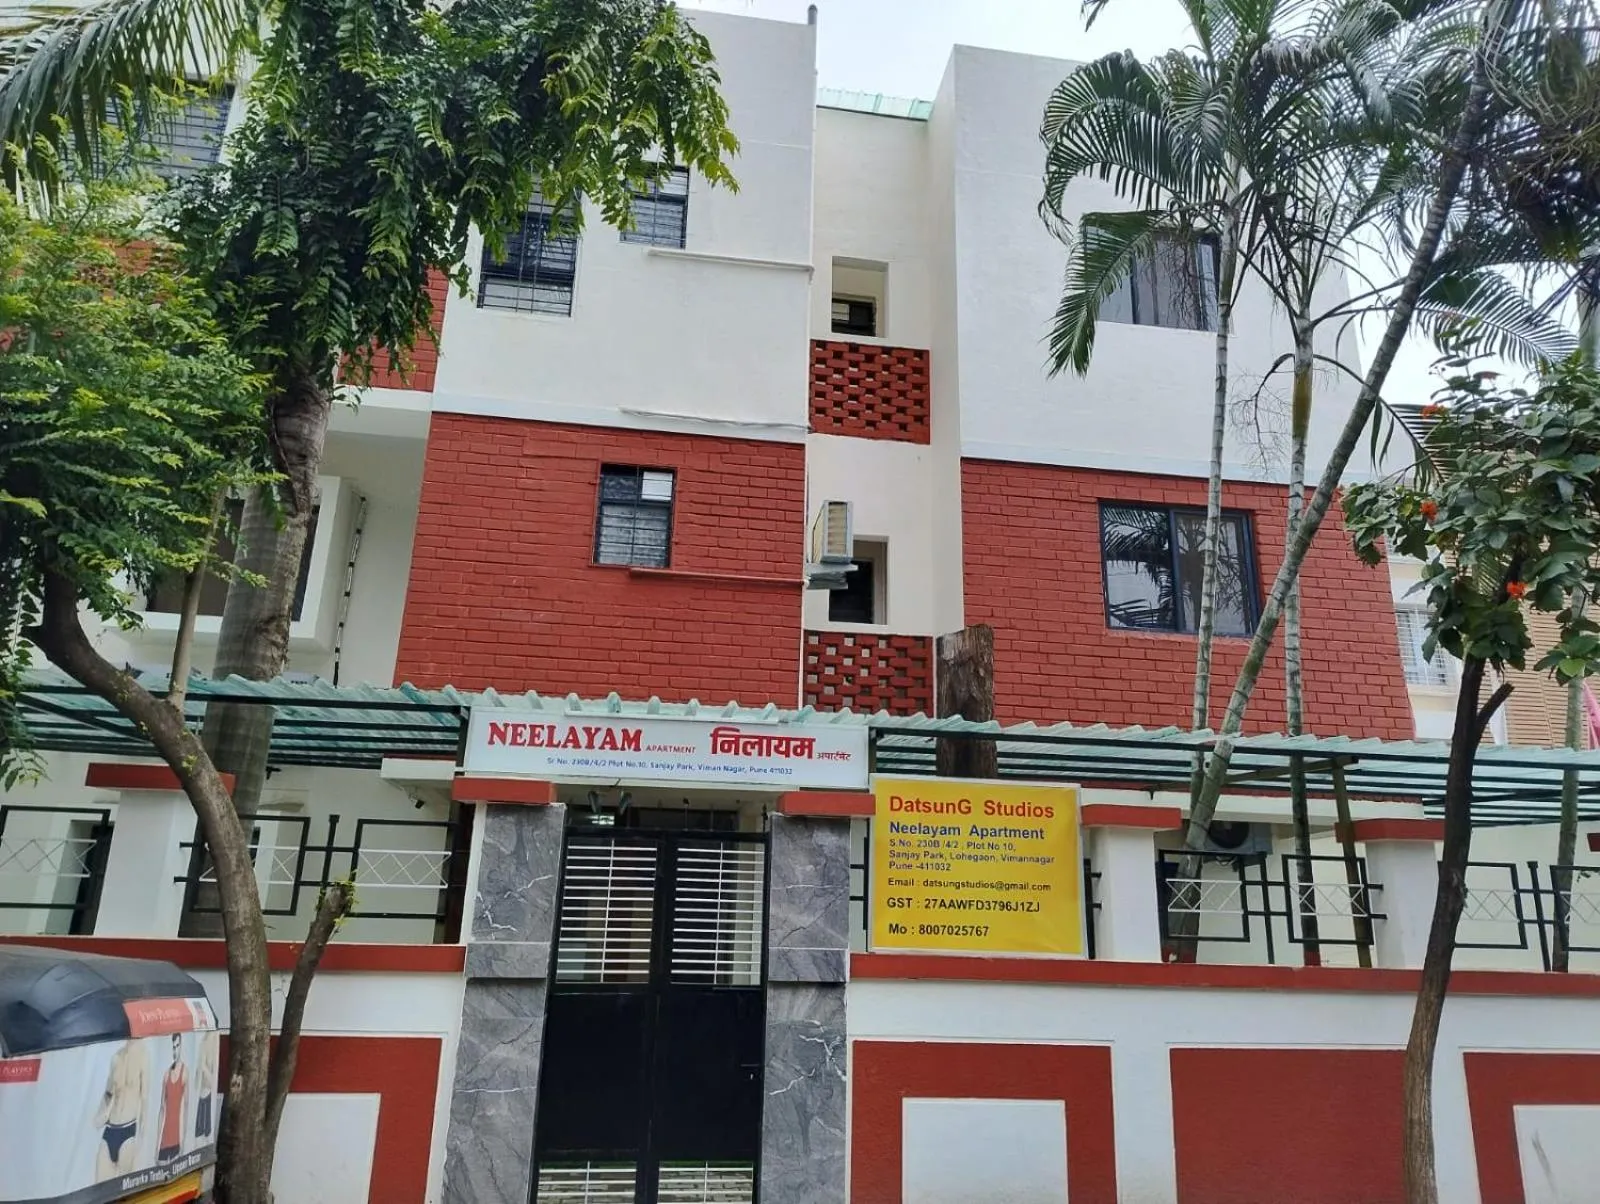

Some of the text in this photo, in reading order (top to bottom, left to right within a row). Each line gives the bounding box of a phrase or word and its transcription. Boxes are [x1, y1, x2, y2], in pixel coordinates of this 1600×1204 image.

[487, 722, 697, 754] NEELAYAM APARTMENT
[709, 725, 816, 760] निलायम
[608, 759, 623, 768] Plot
[650, 761, 675, 771] Sanjay
[677, 762, 696, 771] Park,
[698, 763, 721, 771] Viman
[749, 766, 768, 774] Pune
[889, 796, 1055, 818] DatsunG Studios
[889, 821, 1045, 840] Neelayam Apartment
[916, 839, 941, 848] 230B
[966, 841, 985, 850] Plot
[889, 849, 920, 860] Sanjay
[1000, 854, 1055, 865] Vimannagar
[888, 860, 913, 870] Pune
[887, 877, 915, 887] Email
[922, 879, 1051, 891] datsungstudios@gmail.com
[886, 897, 913, 909] GST
[924, 898, 1041, 912] 27AAWFD3796J1ZJ
[888, 923, 908, 935] Mo
[918, 924, 990, 937] 8007025767
